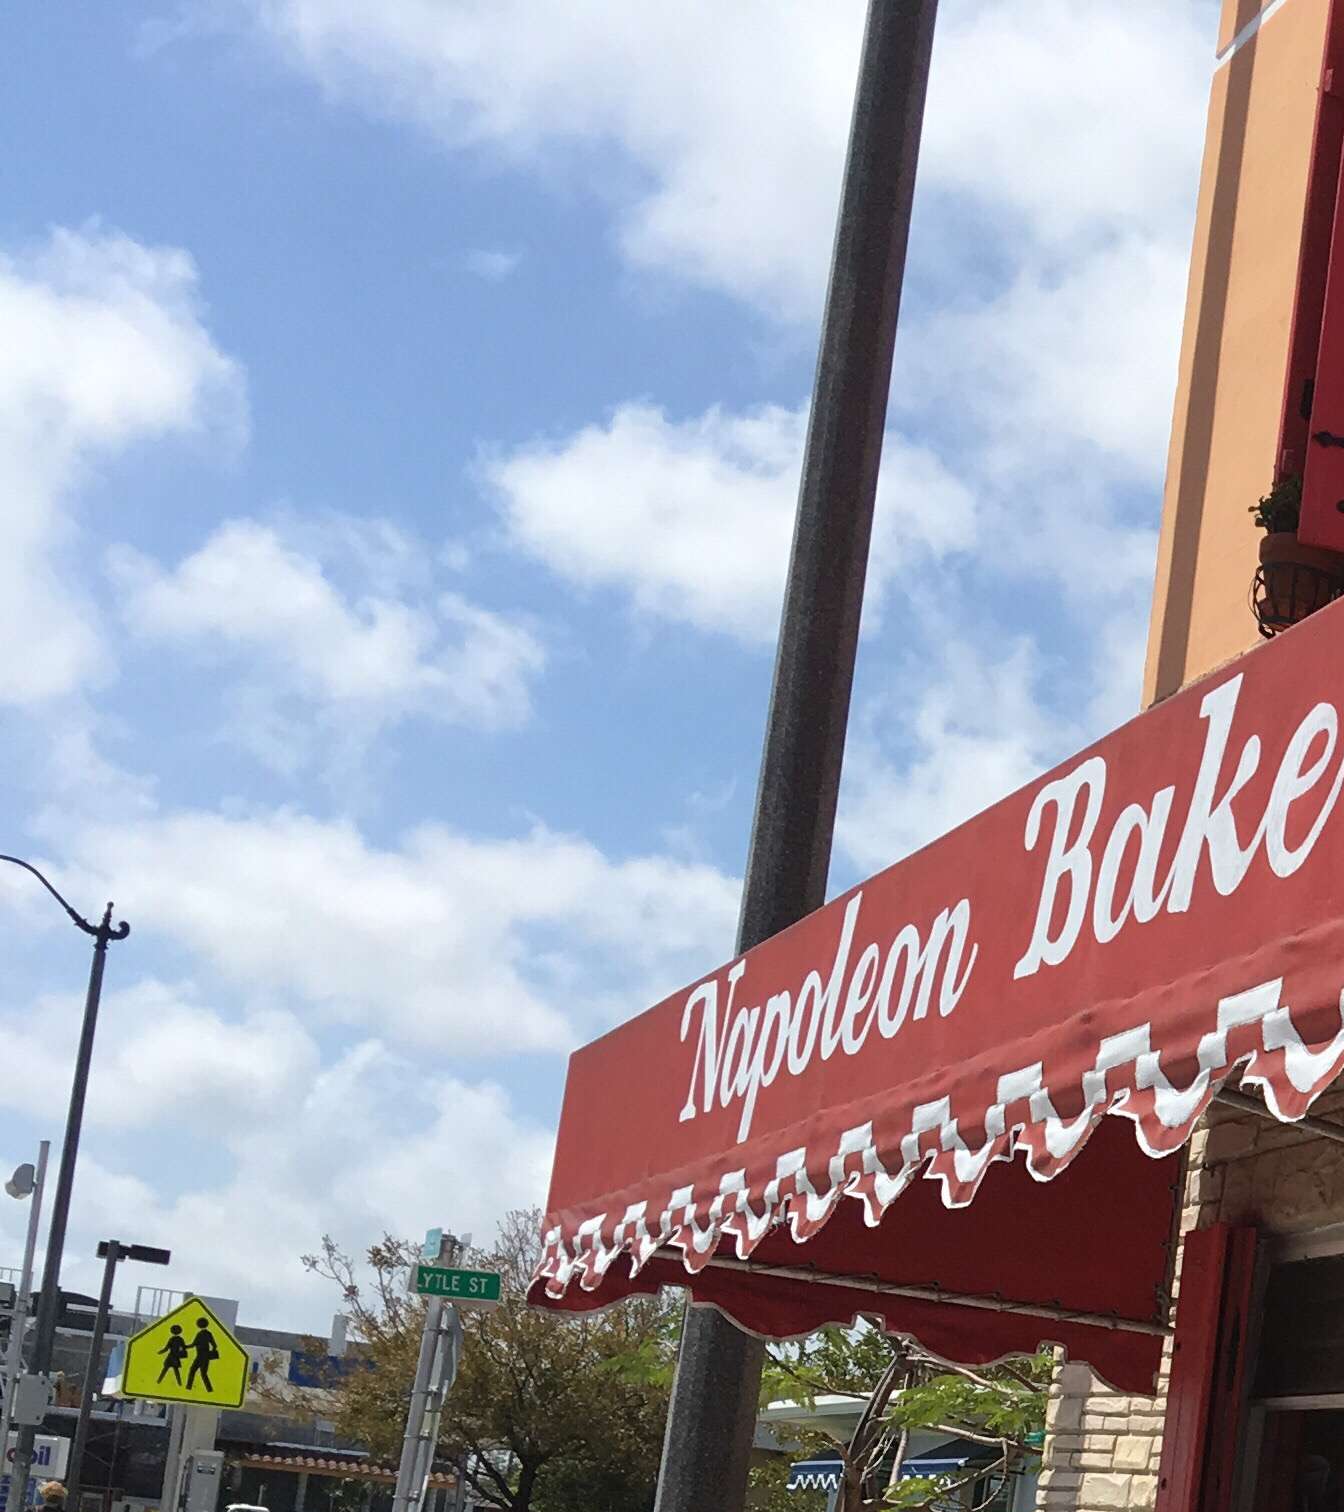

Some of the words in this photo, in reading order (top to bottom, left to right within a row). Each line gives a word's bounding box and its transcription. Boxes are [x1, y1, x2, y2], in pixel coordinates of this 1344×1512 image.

[680, 891, 978, 1143] Napoleon
[417, 1272, 460, 1292] YTLE
[469, 1277, 488, 1294] ST
